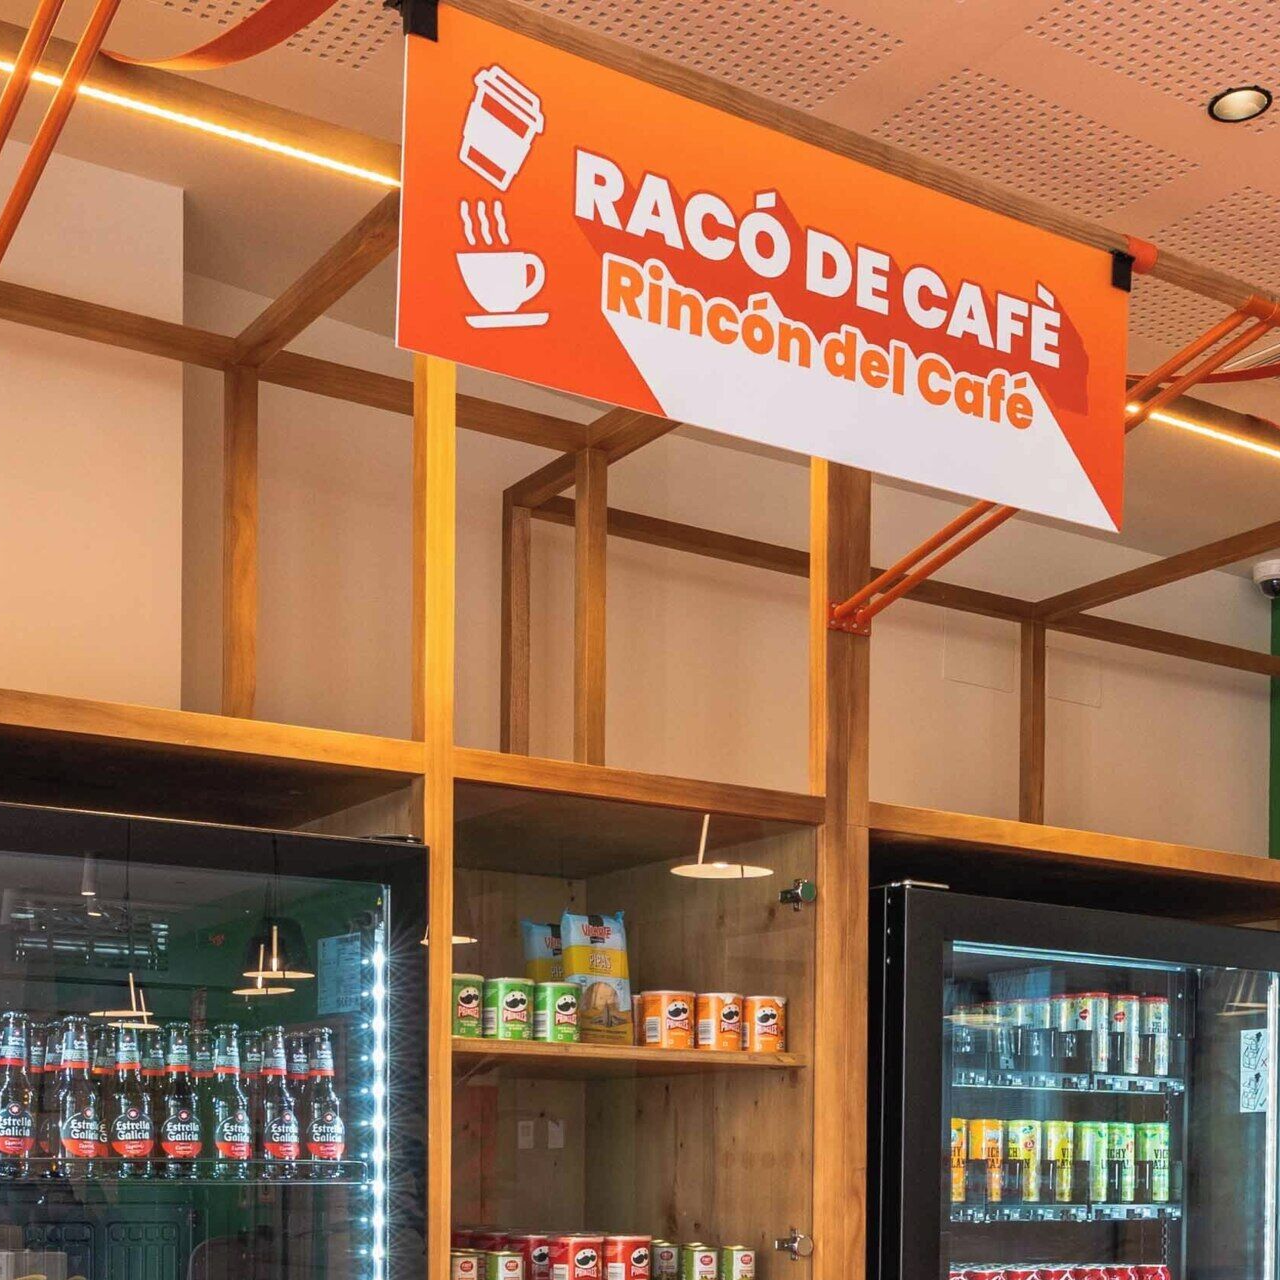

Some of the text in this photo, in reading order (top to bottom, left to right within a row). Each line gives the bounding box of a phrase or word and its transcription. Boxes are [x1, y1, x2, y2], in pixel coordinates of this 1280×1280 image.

[574, 148, 1061, 369] RACÓ DE CAFÈ
[605, 256, 1035, 431] Rincón del Café
[116, 1121, 150, 1131] Estrella
[166, 1122, 200, 1132] Estrella
[117, 1130, 150, 1140] Galicia
[167, 1132, 198, 1142] Galicia
